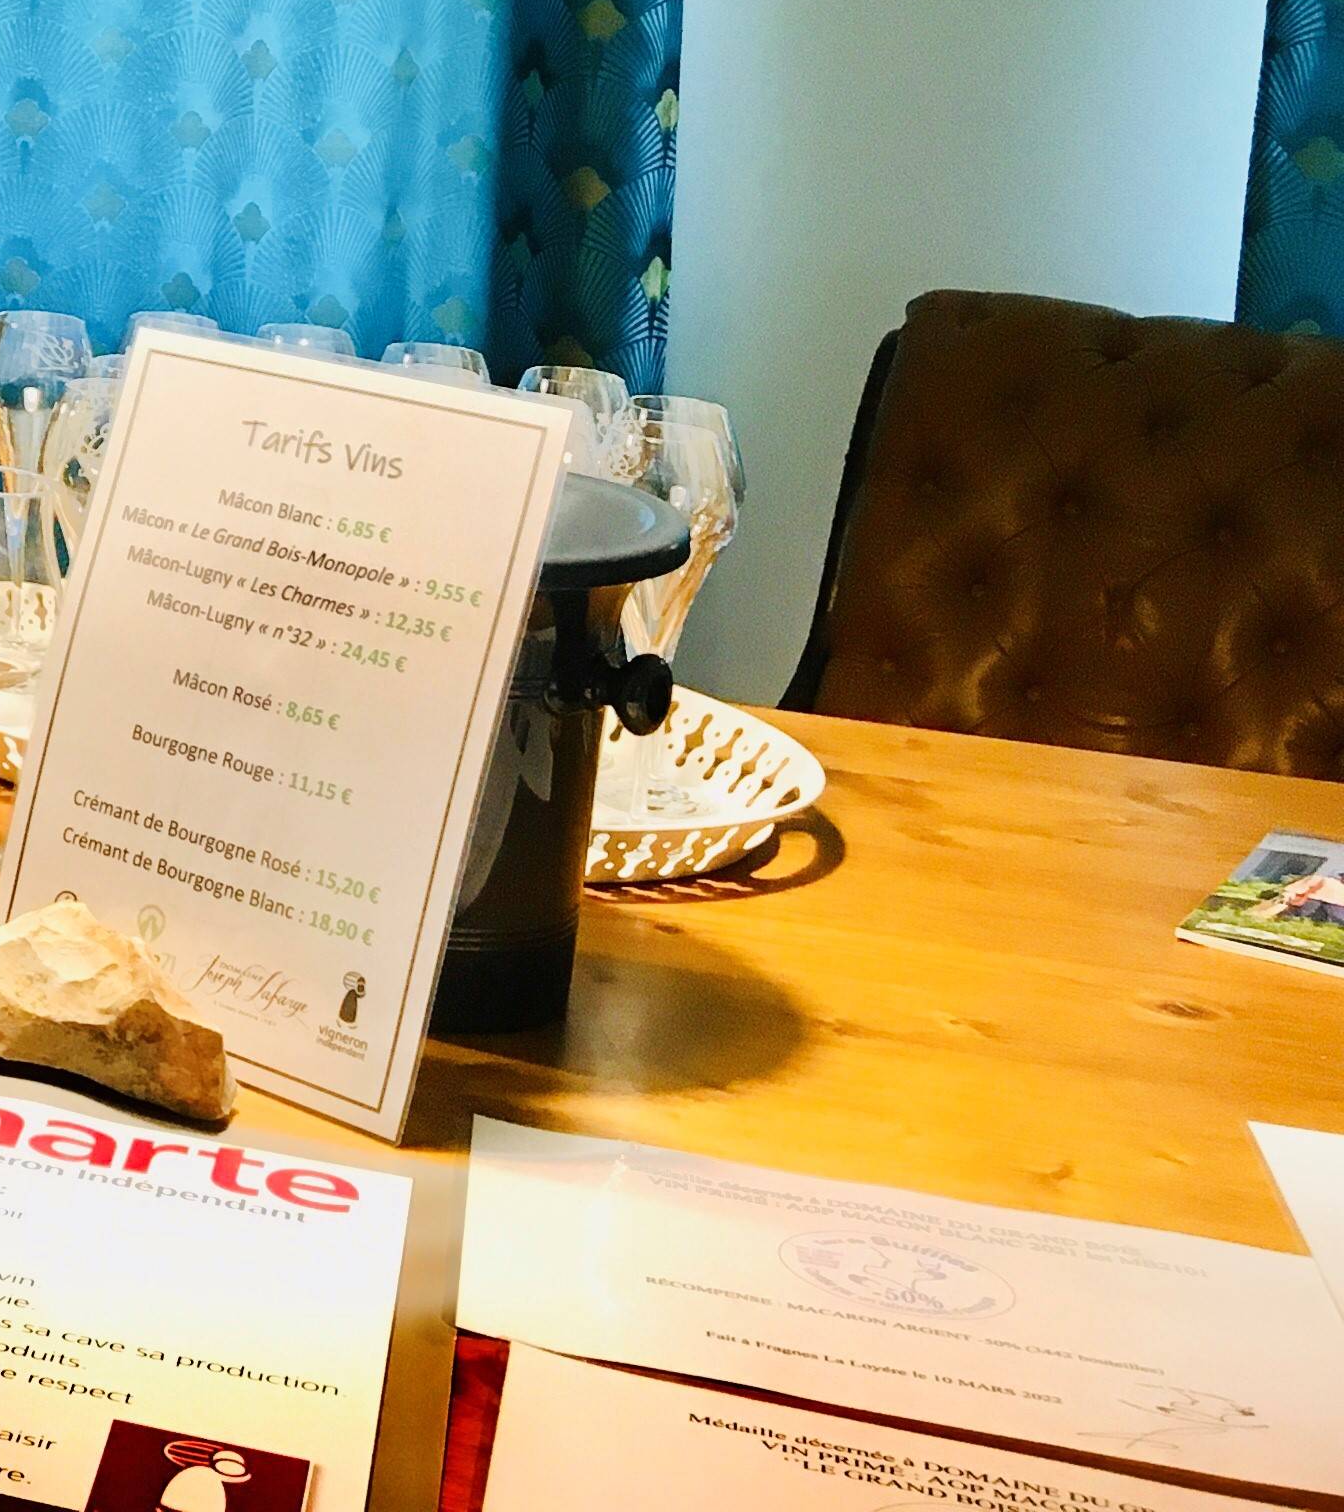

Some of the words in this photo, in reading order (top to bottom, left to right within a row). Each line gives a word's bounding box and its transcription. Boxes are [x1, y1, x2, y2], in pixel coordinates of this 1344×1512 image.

[242, 419, 333, 465] Tarifs
[345, 442, 404, 480] Vins
[218, 488, 273, 518] Mâcon
[277, 502, 324, 528] Blanc
[336, 516, 374, 542] 6,85
[378, 525, 392, 544] €
[121, 504, 174, 532] Mâcon
[191, 522, 210, 540] Le
[213, 527, 265, 554] Grand
[266, 541, 395, 588] Bois-Monopole
[425, 578, 466, 604] 9,55
[469, 589, 483, 608] €
[126, 545, 234, 589] Mâcon-Lugny
[250, 576, 277, 598] Les
[281, 583, 355, 619] Charmes
[385, 609, 437, 640] 12,35
[439, 624, 454, 643] €
[146, 589, 255, 635] Mâcon-Lugny
[340, 640, 390, 670] 24,45
[394, 655, 408, 674] €
[172, 669, 229, 700] Mâcon
[232, 686, 273, 713] Rosé
[285, 700, 324, 727] 8,65
[327, 713, 341, 731] €
[132, 724, 219, 765] Bourgogne
[222, 752, 275, 784] Rouge
[287, 772, 337, 801] 11,15
[340, 787, 354, 806] €
[73, 789, 140, 826] Crémant
[143, 812, 165, 832] de
[167, 820, 257, 865] Bourgogne
[260, 850, 301, 878] Rosé
[315, 869, 365, 900] 15,20
[368, 885, 382, 905] €
[62, 826, 130, 864] Crémant
[132, 850, 154, 871] de
[156, 858, 246, 903] Bourgogne
[249, 889, 296, 921] Blanc
[309, 910, 359, 941] 18,90
[361, 928, 376, 948] €
[318, 1023, 370, 1052] vigneron
[76, 1167, 308, 1224] Indépendant
[826, 1197, 941, 1226] DOMAINE
[947, 1217, 984, 1233] DU
[840, 1208, 932, 1235] MACON
[938, 1227, 1024, 1249] BLANC
[645, 1274, 773, 1307] RÉCOMPENSE
[786, 1300, 888, 1327] MACARON
[892, 1321, 972, 1342] ARGENT
[872, 1286, 946, 1312] -50%
[23, 1321, 51, 1339] sa
[60, 1329, 127, 1355] cave
[135, 1345, 166, 1363] sa
[175, 1354, 348, 1399] production.
[26, 1370, 136, 1407] respect
[705, 1329, 738, 1344] Fait
[740, 1336, 752, 1346] à
[823, 1354, 846, 1366] La
[911, 1369, 928, 1381] le
[934, 1373, 955, 1386] 10
[957, 1378, 1018, 1397] MARS
[1021, 1390, 1065, 1406] 2022
[687, 1412, 788, 1442] Médaille
[793, 1434, 897, 1464] décernée
[902, 1455, 916, 1468] à
[922, 1459, 1061, 1499] DOMAINE
[1068, 1490, 1111, 1509] DU
[760, 1438, 810, 1458] VIN
[816, 1450, 906, 1478] PRIMÉ
[927, 1474, 986, 1493] AOP
[843, 1468, 949, 1500] GRAND
